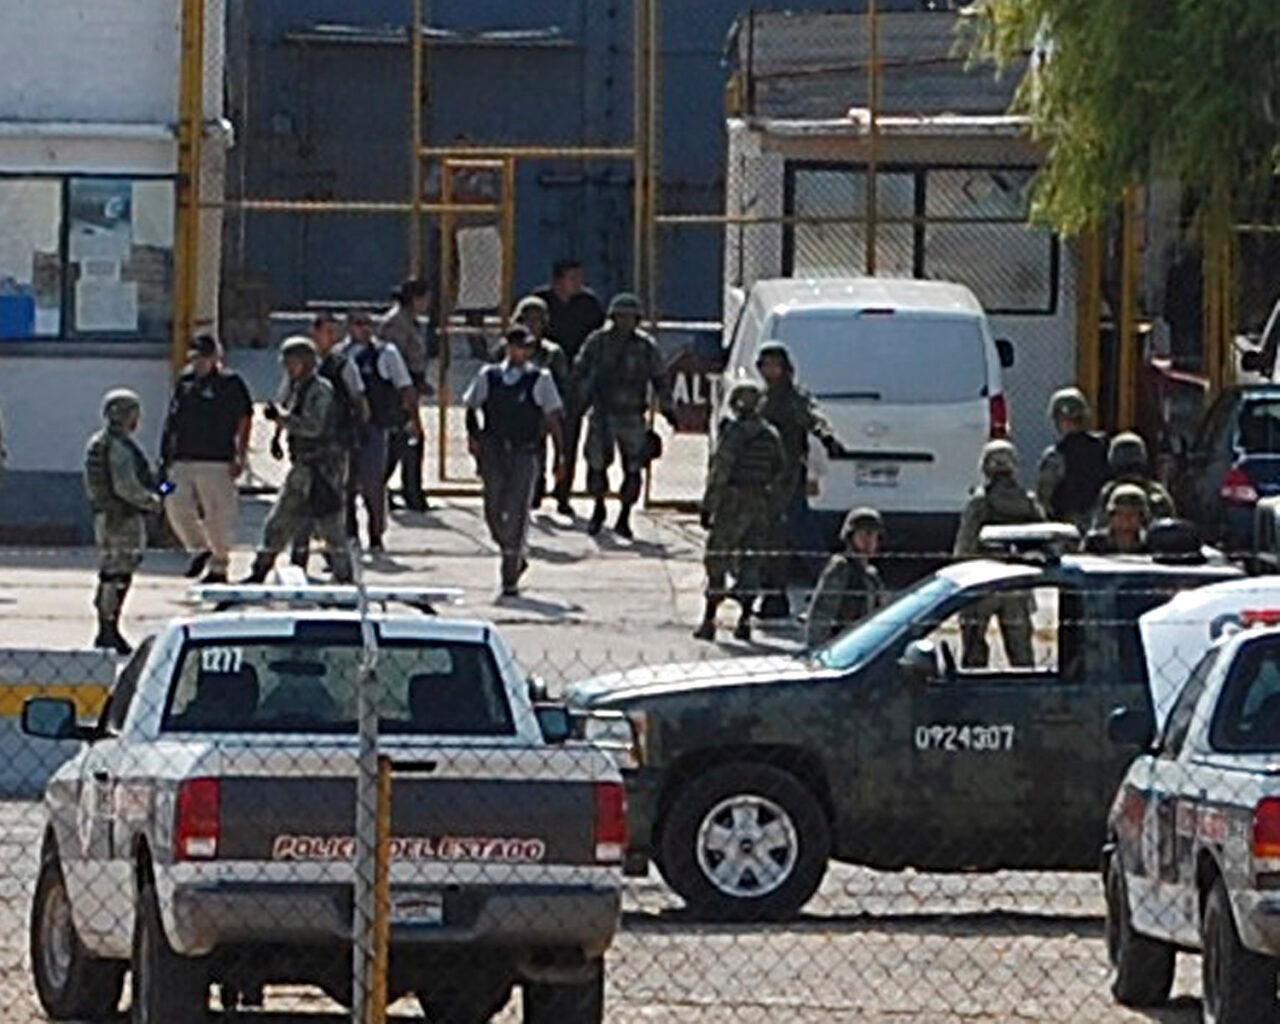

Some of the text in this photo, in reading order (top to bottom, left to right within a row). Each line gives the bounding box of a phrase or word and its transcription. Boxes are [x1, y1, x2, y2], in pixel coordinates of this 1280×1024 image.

[672, 372, 721, 405] ALT
[915, 725, 1015, 751] 0924307
[273, 835, 546, 861] POLIC DEL ESTADO
